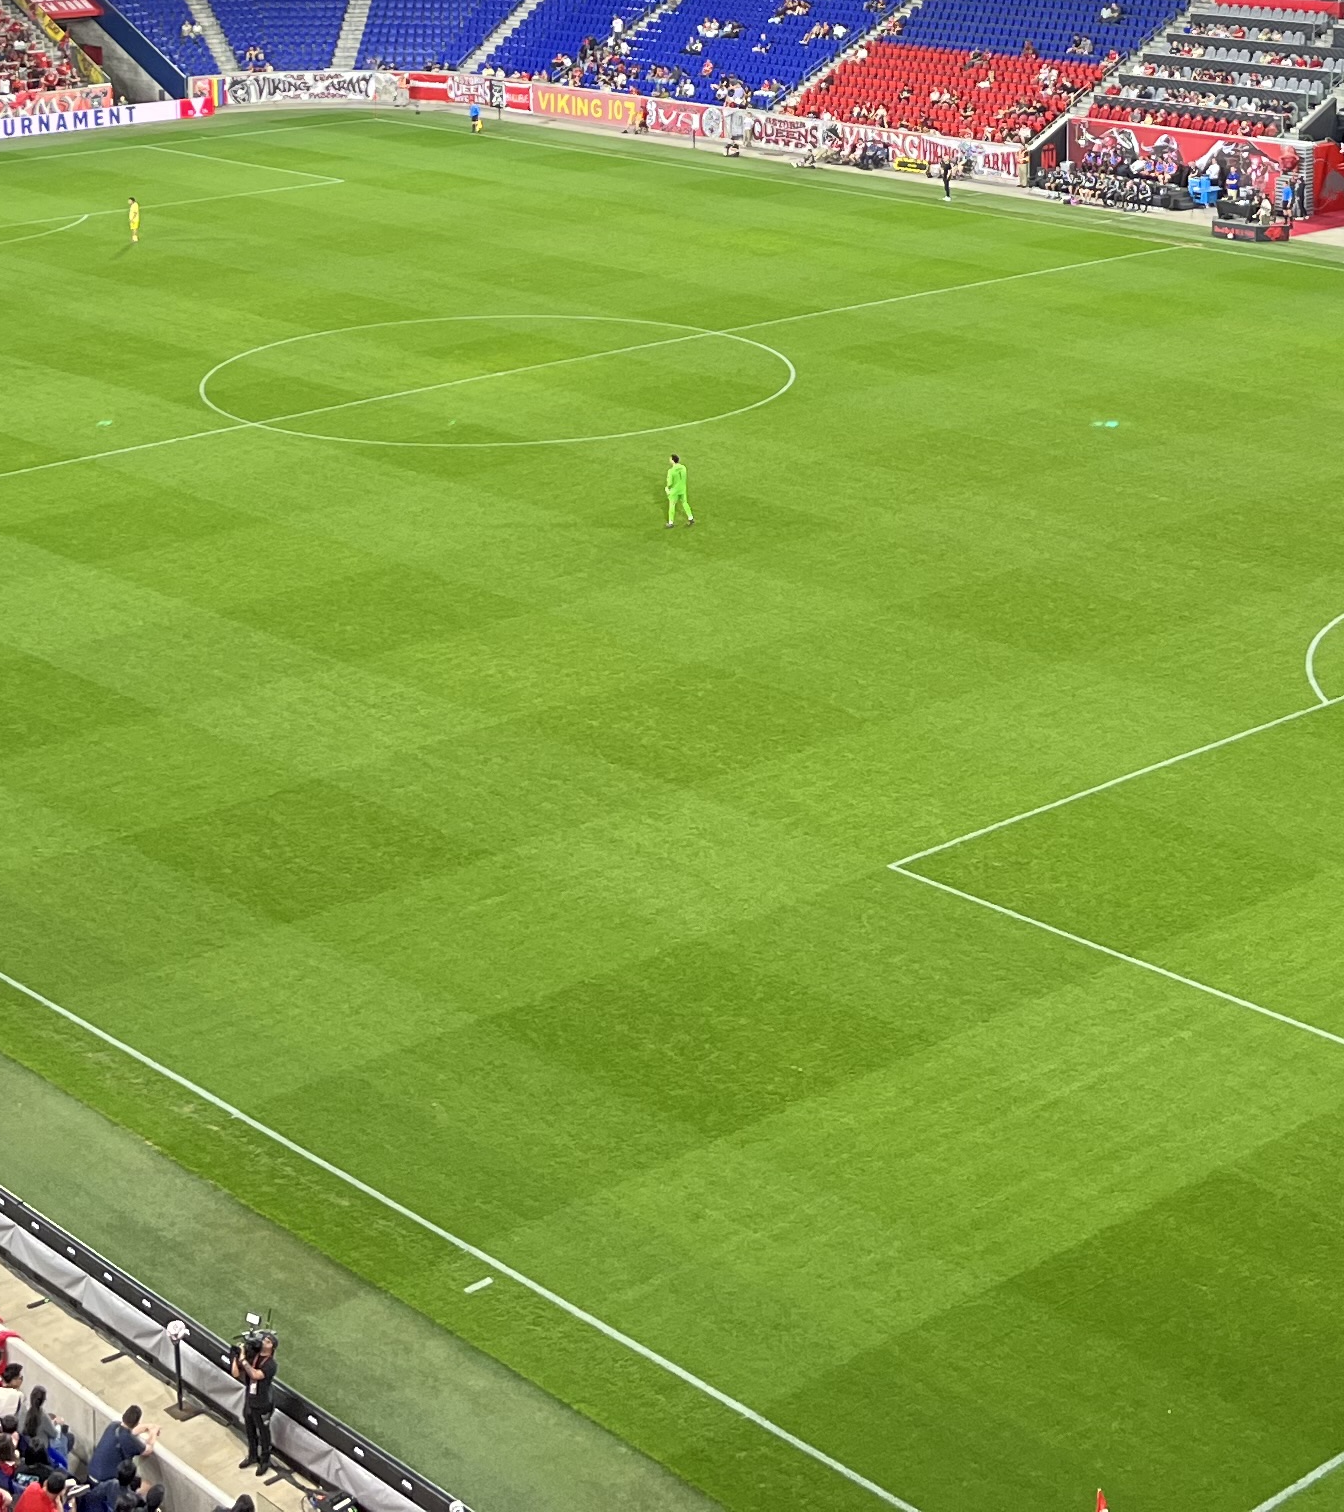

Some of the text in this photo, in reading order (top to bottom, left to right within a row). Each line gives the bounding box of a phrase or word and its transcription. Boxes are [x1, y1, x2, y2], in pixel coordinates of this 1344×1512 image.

[256, 74, 373, 97] VIKING ARMY
[537, 90, 603, 118] VIKING
[608, 101, 636, 123] 107
[753, 118, 818, 145] QUEENS
